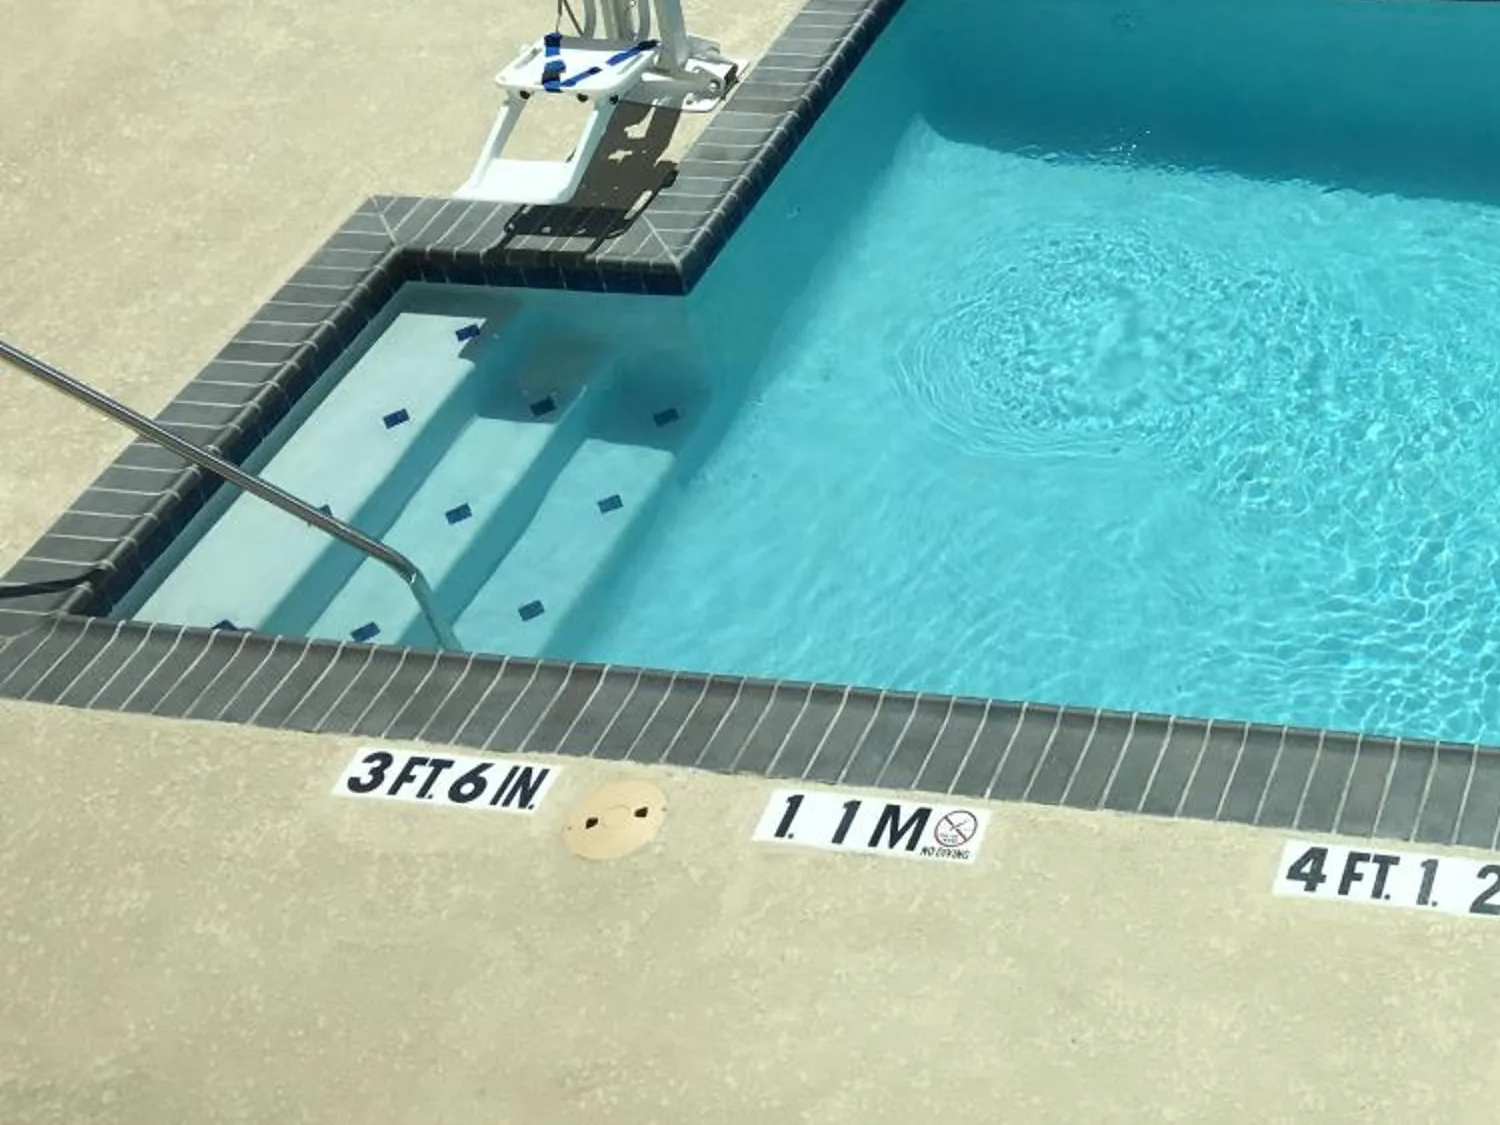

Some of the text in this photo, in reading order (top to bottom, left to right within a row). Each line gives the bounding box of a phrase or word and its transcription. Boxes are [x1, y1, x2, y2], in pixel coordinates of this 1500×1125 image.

[347, 751, 551, 810] 3 FT. 6 IN.
[868, 803, 933, 851] M
[1286, 845, 1329, 893] 4
[1337, 851, 1401, 901] FT.
